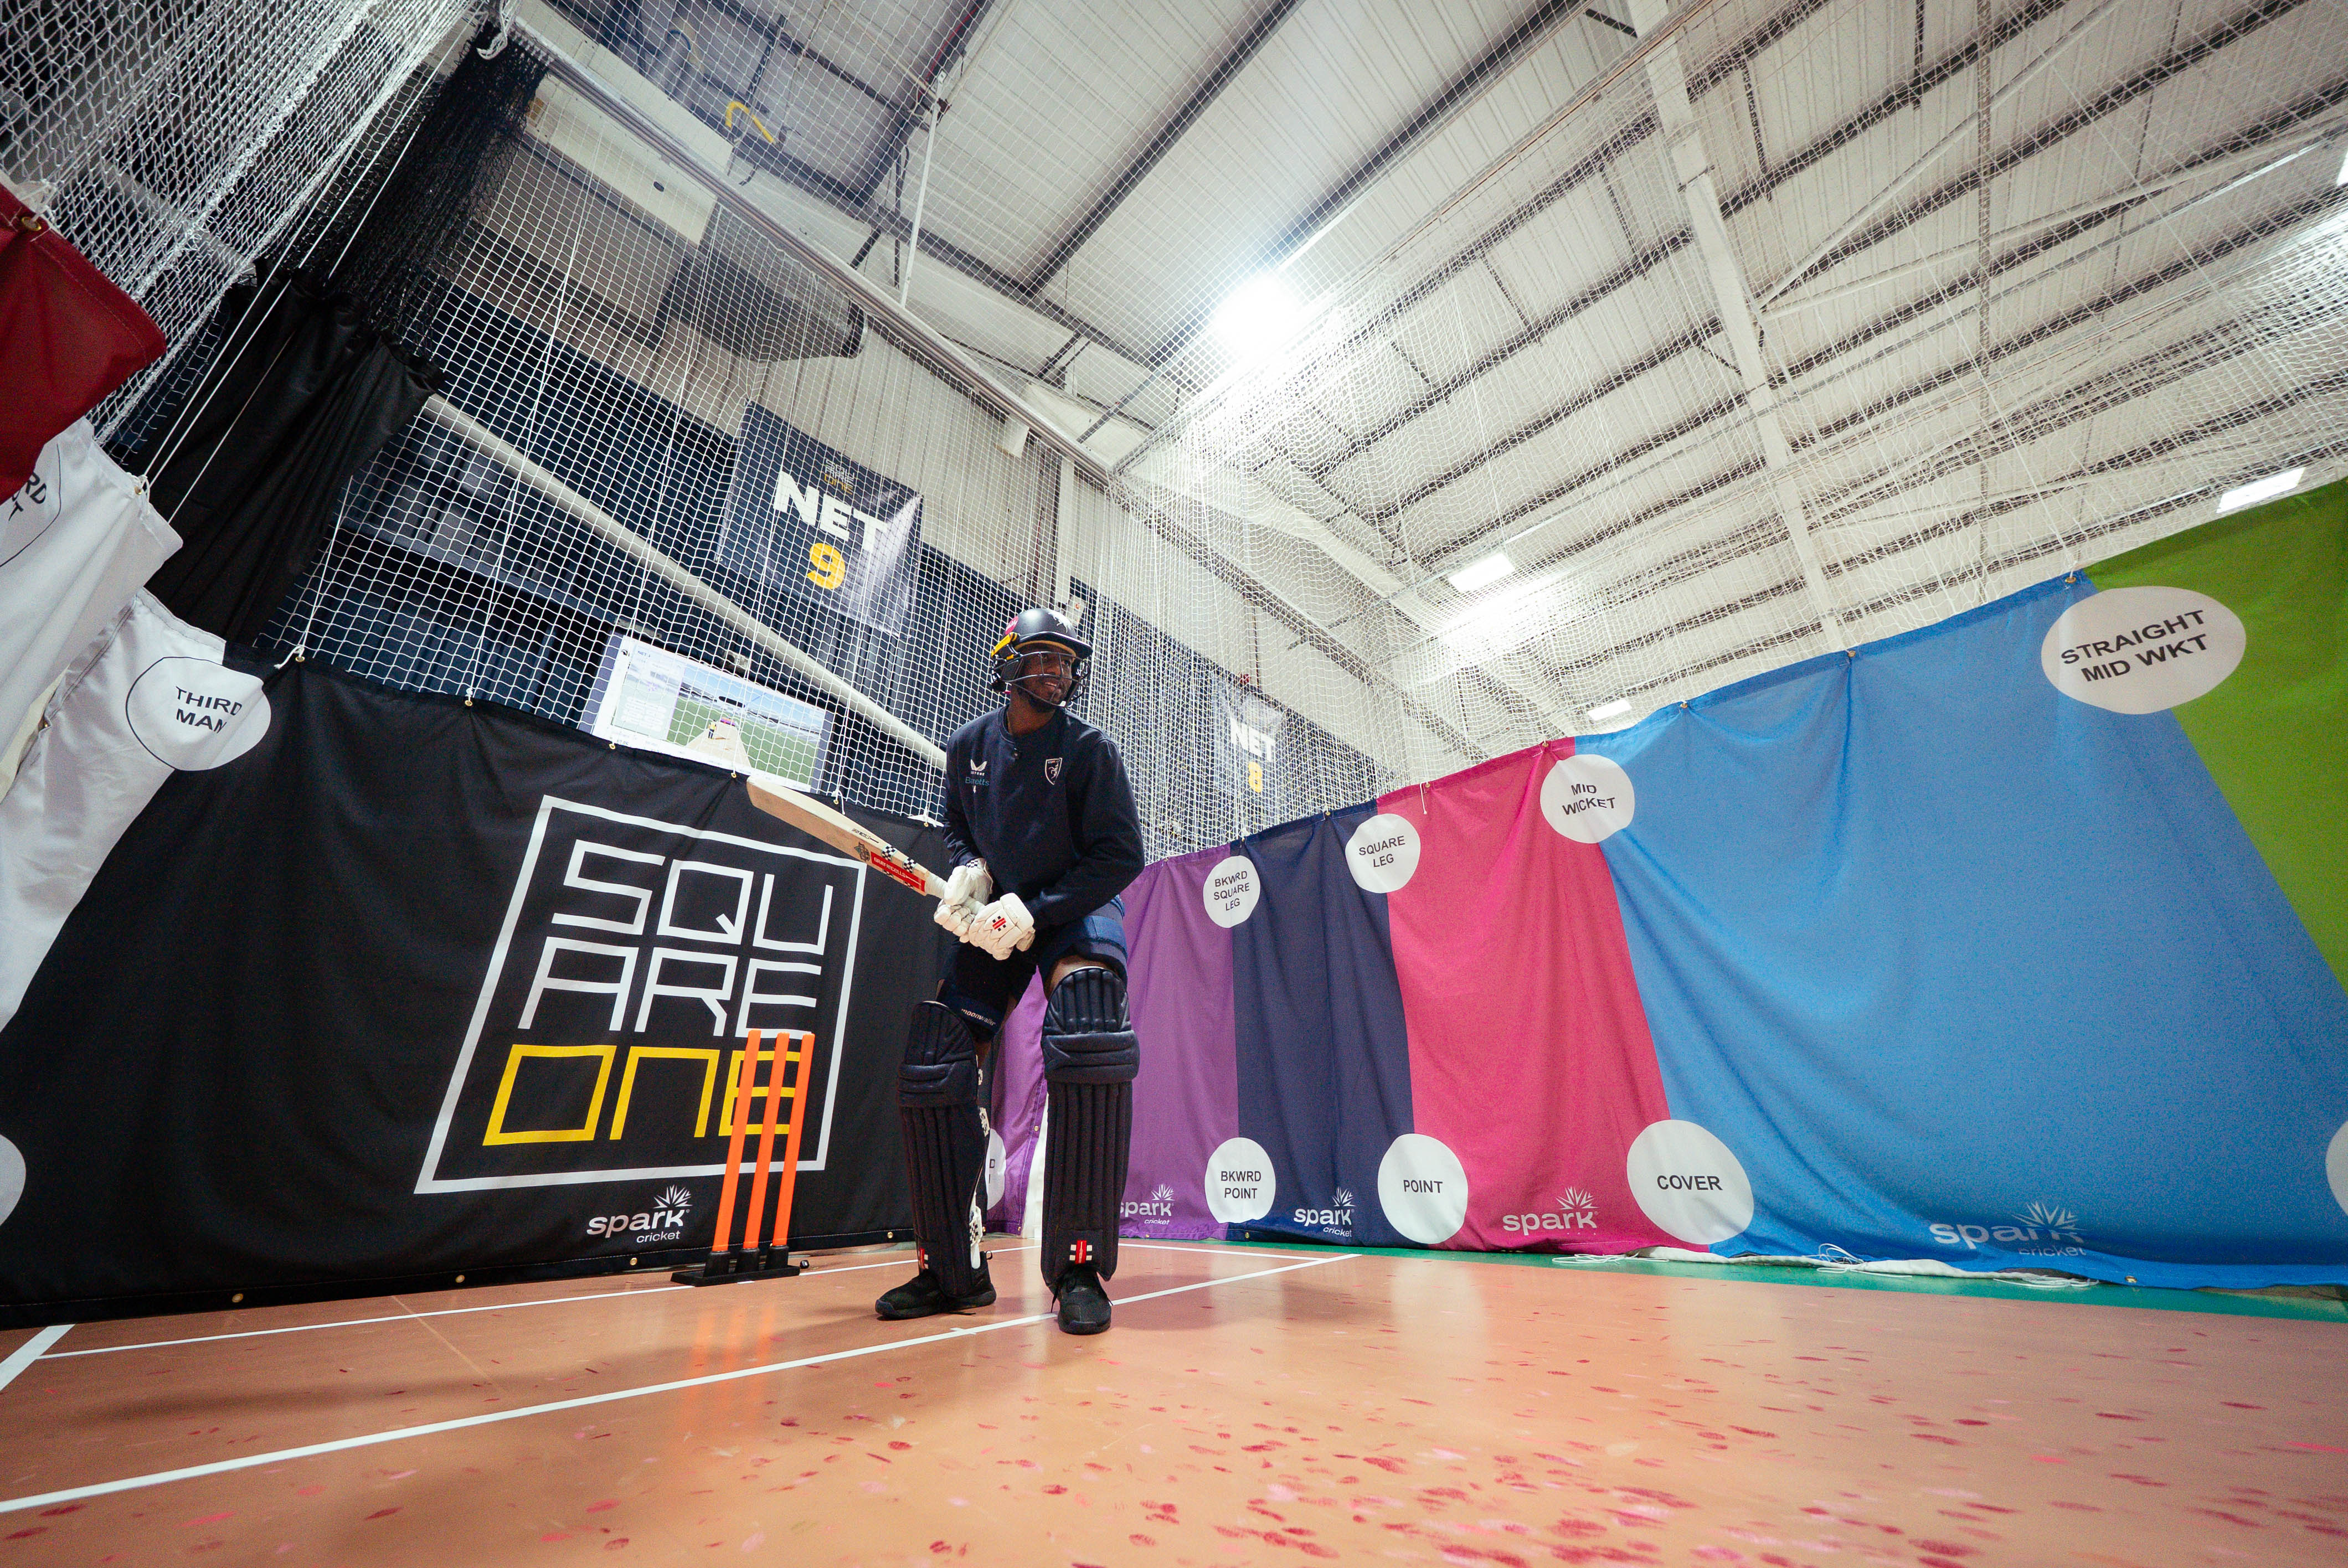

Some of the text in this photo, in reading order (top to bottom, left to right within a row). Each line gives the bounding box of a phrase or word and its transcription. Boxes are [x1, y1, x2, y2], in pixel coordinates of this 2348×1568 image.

[773, 471, 888, 554] NET
[807, 543, 846, 589] 9
[2061, 610, 2205, 664] STRAIGHT
[2081, 634, 2207, 682] MID WKT
[176, 686, 242, 715] THIRD
[176, 709, 227, 734] MAN
[1230, 718, 1275, 762] NET
[1248, 761, 1263, 793] 8
[1571, 783, 1597, 796] MID
[1562, 797, 1615, 815] WICKET
[1358, 835, 1405, 856] SQUARE
[1373, 853, 1394, 868] LEG
[1214, 871, 1248, 887] BKWRD
[552, 839, 833, 956] SQU
[1214, 883, 1250, 900] SQUARE
[1226, 898, 1240, 911] LEG
[518, 936, 822, 1040] ARE
[1221, 1170, 1261, 1182] BKWRD
[1656, 1174, 1723, 1192] COVER
[1224, 1188, 1258, 1199] POINT
[1403, 1179, 1443, 1194] POINT
[586, 1209, 685, 1239] spark
[1293, 1208, 1352, 1226] spark
[1502, 1211, 1598, 1236] spark
[636, 1230, 681, 1243] cricket
[1322, 1227, 1352, 1237] cricket
